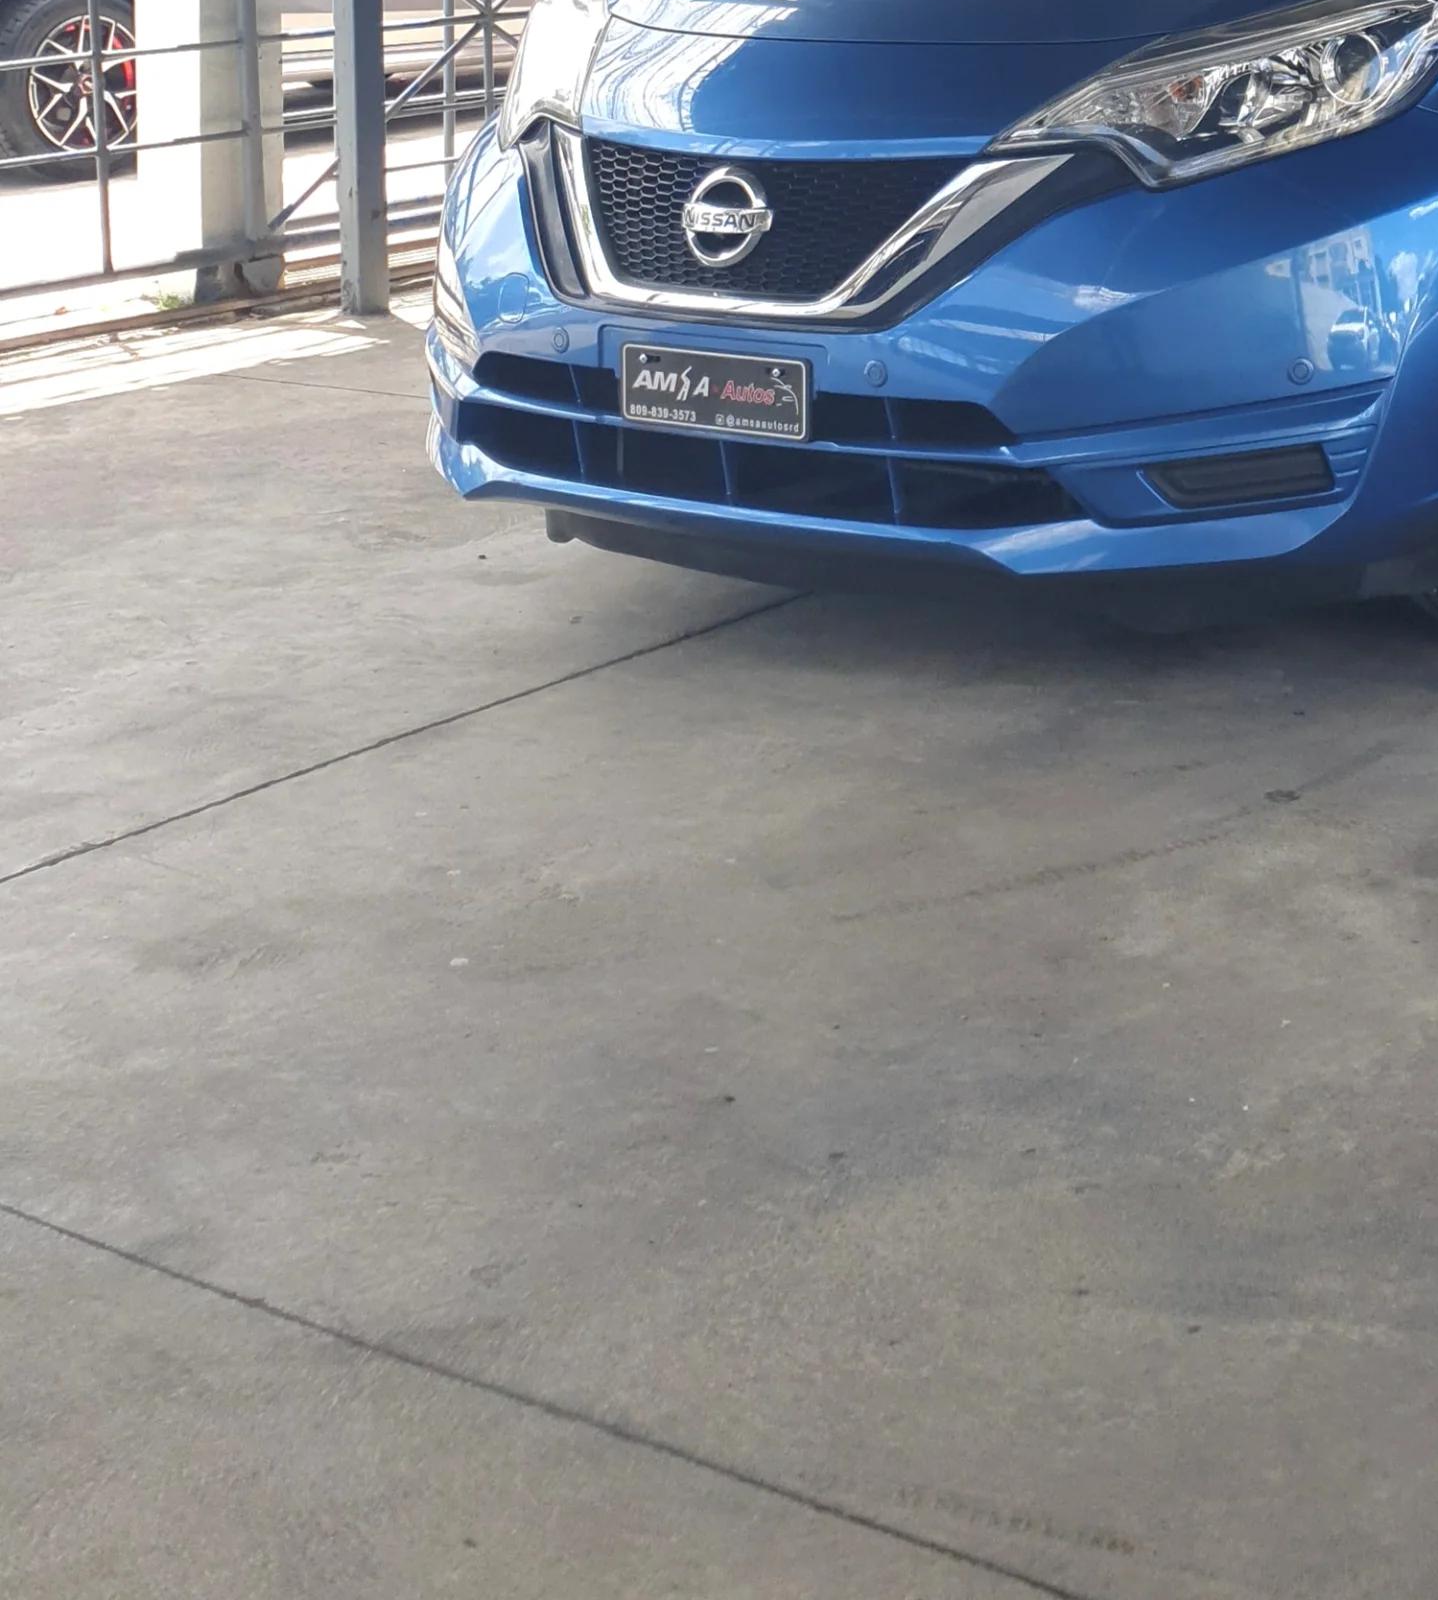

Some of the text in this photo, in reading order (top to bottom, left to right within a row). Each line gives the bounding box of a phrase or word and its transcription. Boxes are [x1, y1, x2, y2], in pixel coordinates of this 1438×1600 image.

[685, 206, 756, 230] NISSAN
[720, 379, 775, 406] Autos
[629, 403, 697, 423] 809-839-3573
